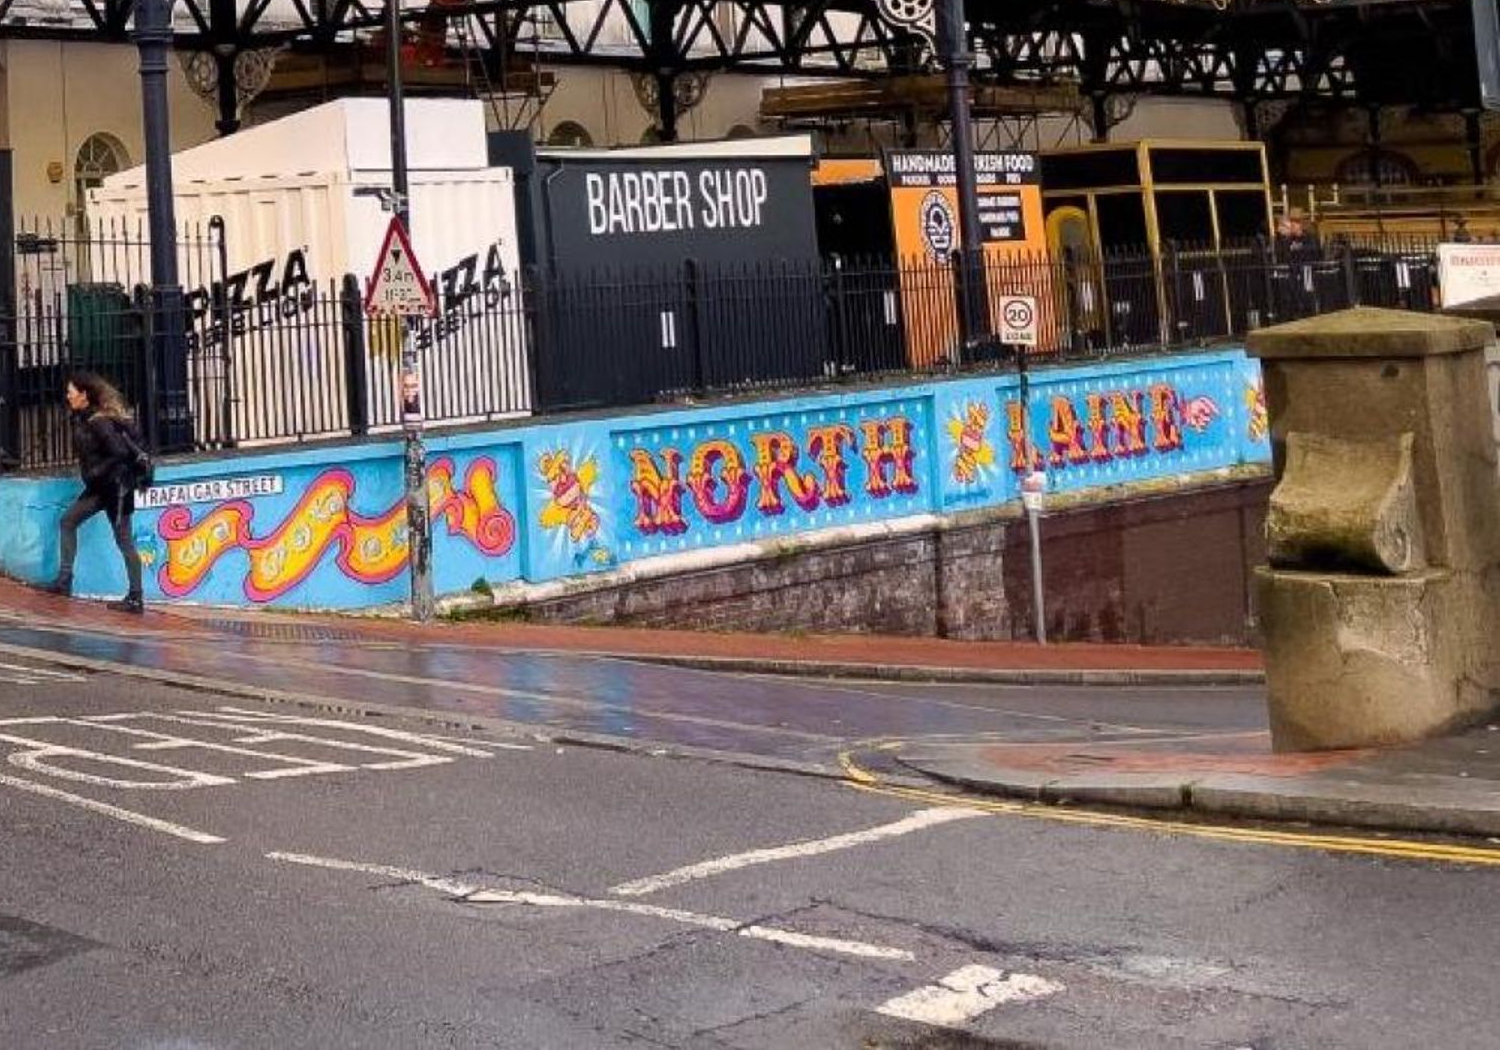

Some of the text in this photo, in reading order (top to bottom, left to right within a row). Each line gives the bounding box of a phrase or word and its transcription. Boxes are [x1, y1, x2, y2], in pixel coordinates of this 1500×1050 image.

[892, 154, 957, 172] HANDMADE
[1006, 154, 1035, 170] FOOD
[586, 167, 768, 235] BARBER SHOP
[184, 248, 311, 336] PIZZA
[1008, 309, 1028, 322] 20
[1007, 382, 1184, 475] LAINE
[142, 476, 275, 506] TRAFALGAR STREET
[630, 415, 919, 537] NORTH
